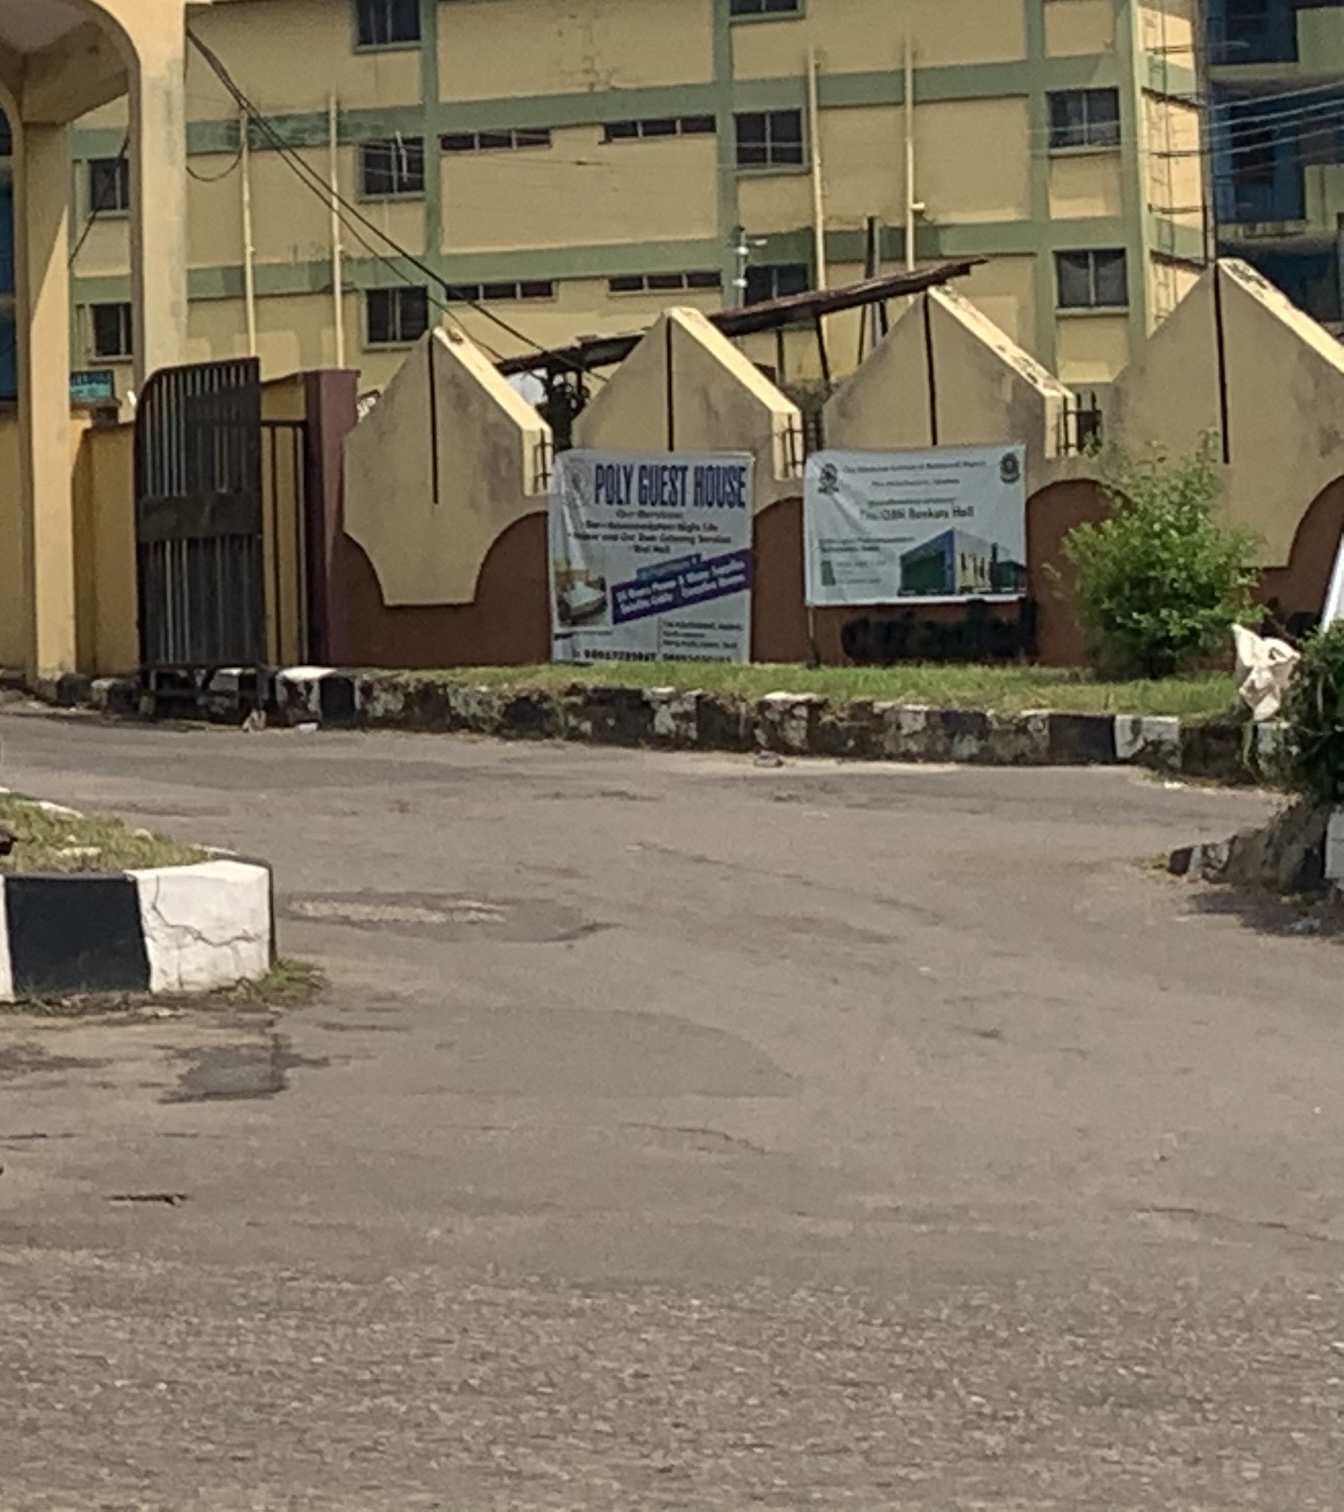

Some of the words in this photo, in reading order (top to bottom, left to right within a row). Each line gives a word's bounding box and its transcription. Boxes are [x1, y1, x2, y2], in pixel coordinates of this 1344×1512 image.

[595, 463, 634, 505] POLY
[637, 464, 689, 507] GUEST
[693, 464, 747, 509] HOUSE
[952, 505, 974, 518] Hall
